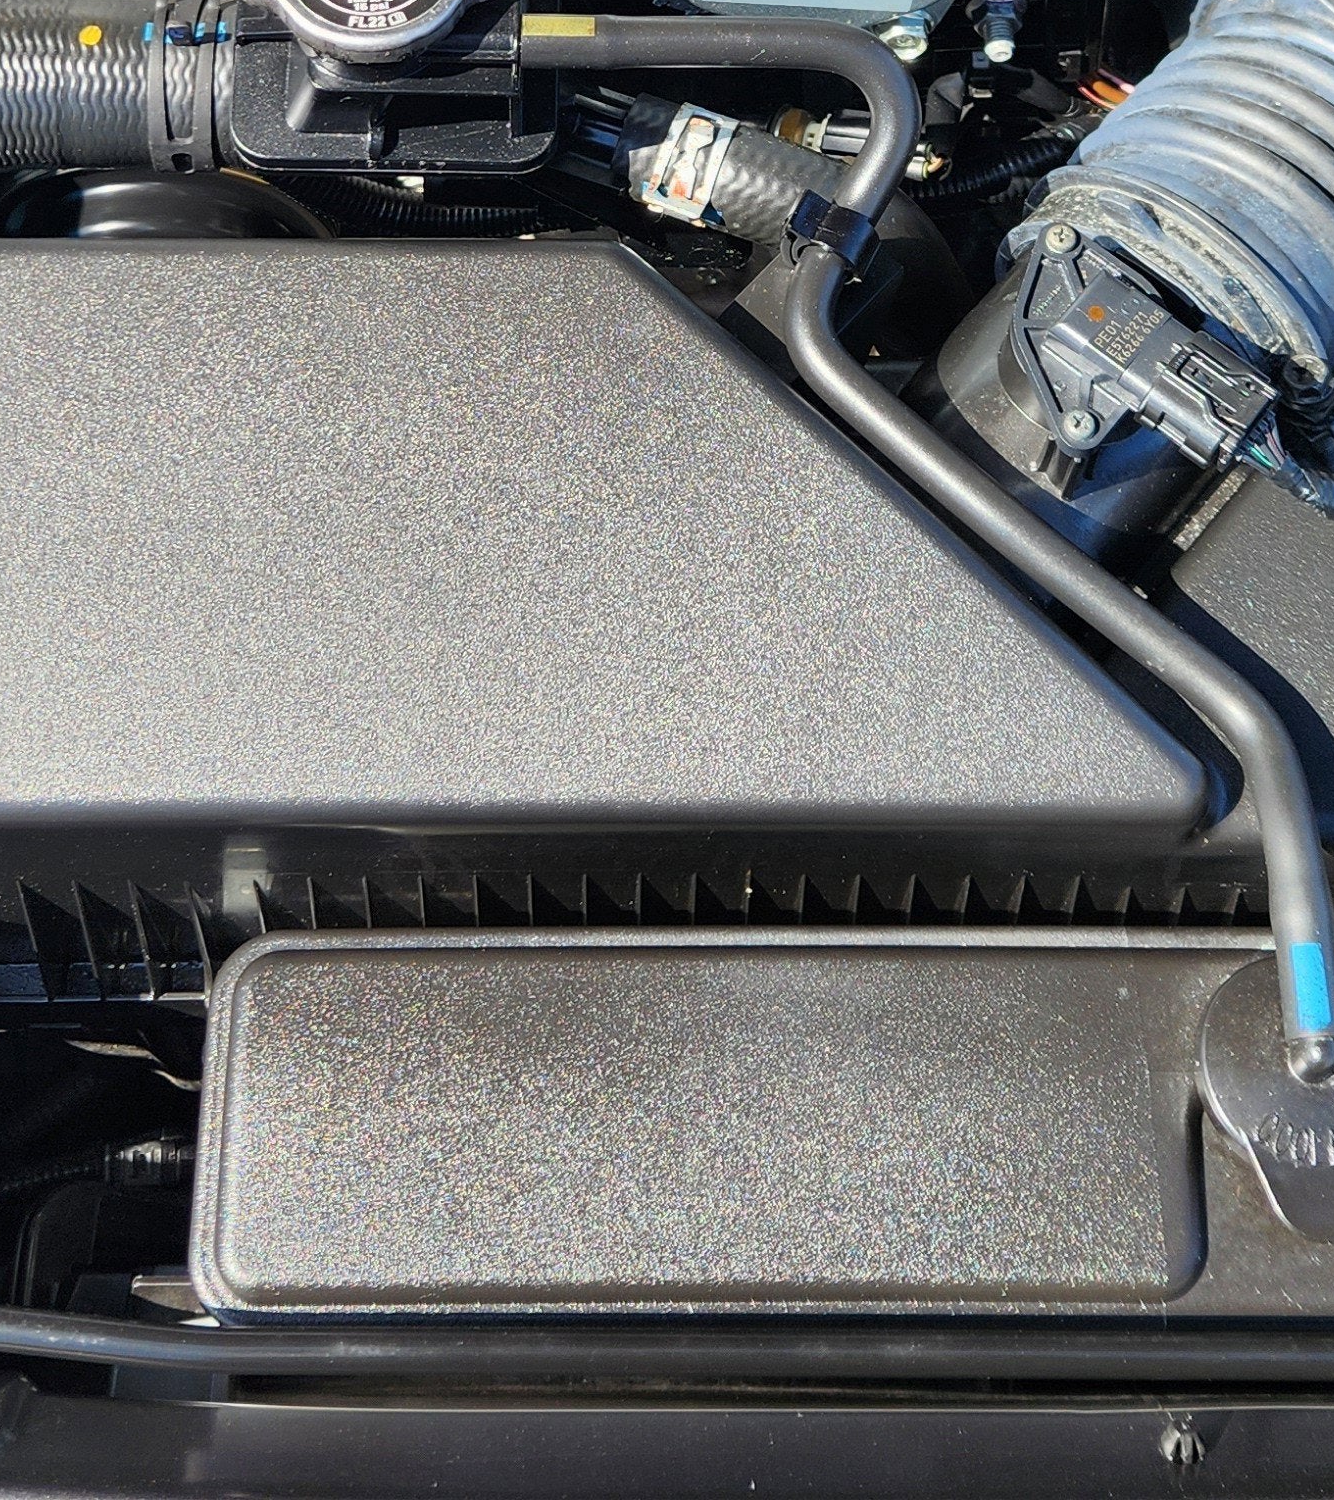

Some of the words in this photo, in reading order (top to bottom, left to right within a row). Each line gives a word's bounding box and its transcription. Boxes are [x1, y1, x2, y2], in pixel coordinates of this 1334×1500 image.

[369, 2, 390, 12] psi
[347, 15, 388, 29] FL22
[1093, 320, 1121, 348] PE01
[1105, 311, 1149, 358] E5T62271
[1116, 332, 1146, 365] K6266
[1141, 308, 1165, 335] 6Y05
